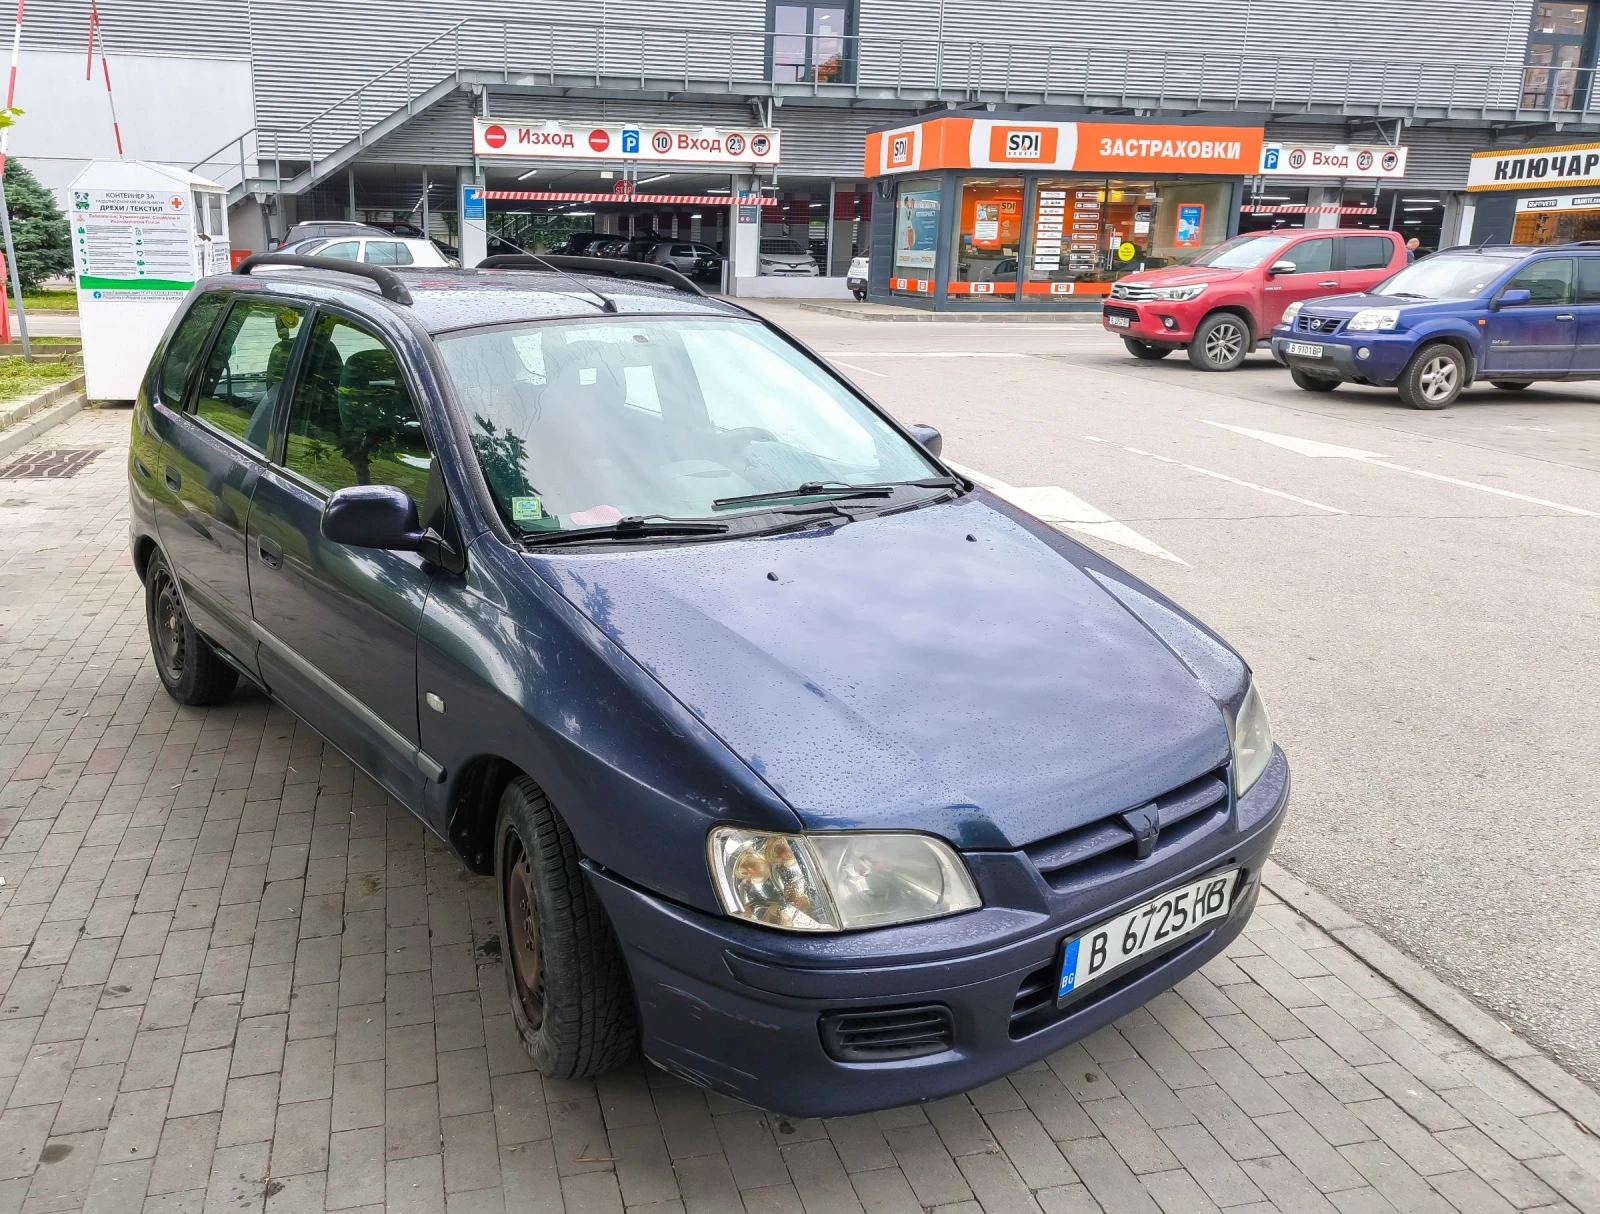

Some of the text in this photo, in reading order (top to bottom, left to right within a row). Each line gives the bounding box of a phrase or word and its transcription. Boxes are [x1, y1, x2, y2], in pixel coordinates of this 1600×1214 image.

[518, 128, 575, 148] Изход
[626, 138, 636, 152] P
[655, 137, 668, 148] 10
[677, 134, 722, 153] Вход
[1008, 134, 1039, 151] SDI
[894, 140, 907, 157] SDI
[1099, 138, 1241, 160] ЗАСТРАХОВКИ
[1267, 155, 1277, 168] P
[1292, 154, 1303, 165] 10
[1312, 152, 1349, 168] Вход
[1494, 154, 1600, 180] КЛЮЧАР
[105, 192, 145, 200] КОНТЕЙНЕР
[615, 186, 632, 195] STP
[100, 204, 124, 212] ДРЕХИ
[1001, 202, 1015, 210] SDI
[1291, 344, 1296, 353] B
[1088, 931, 1108, 975] B
[1061, 972, 1075, 989] BG
